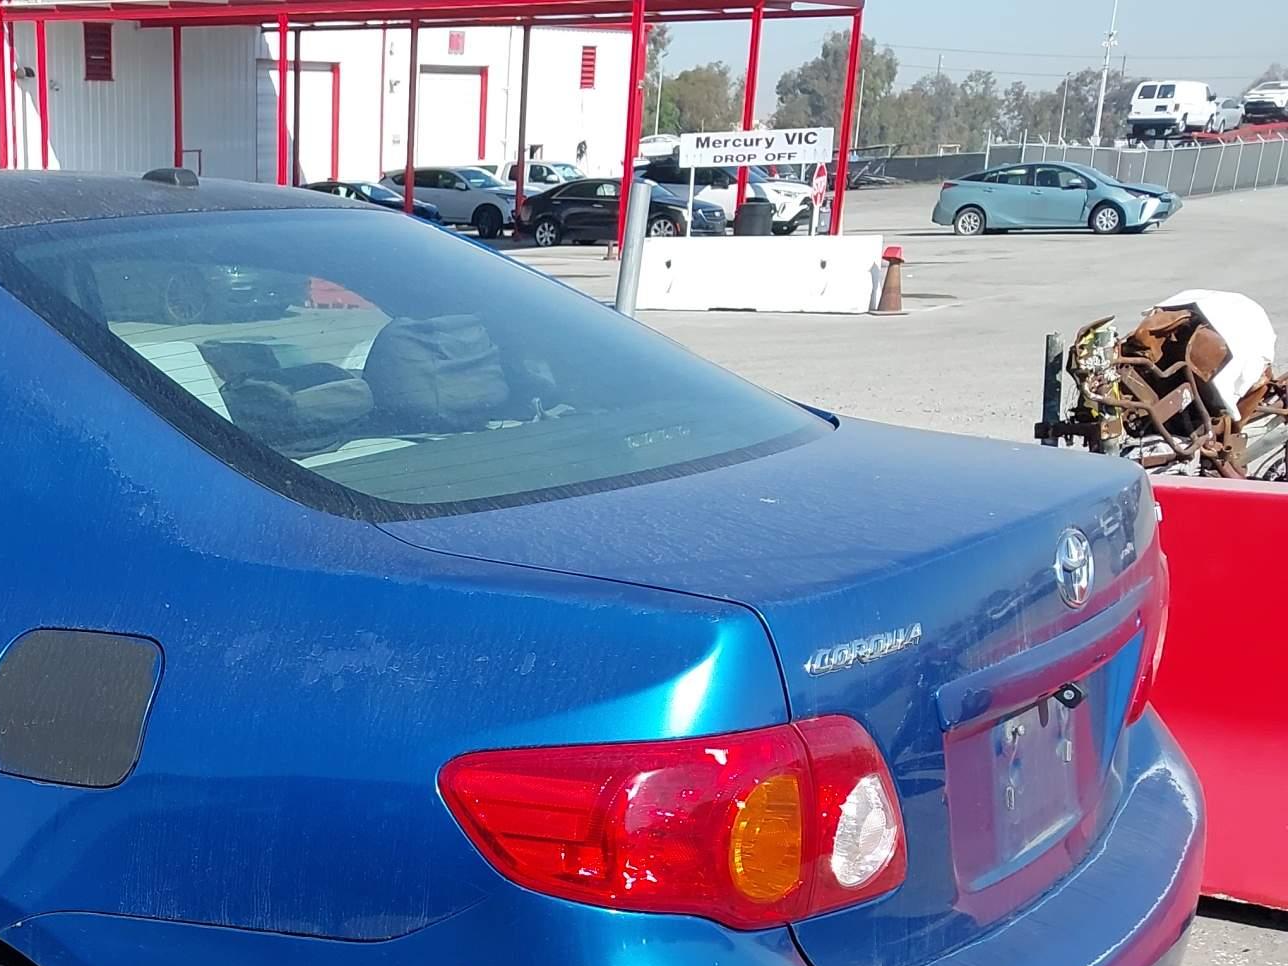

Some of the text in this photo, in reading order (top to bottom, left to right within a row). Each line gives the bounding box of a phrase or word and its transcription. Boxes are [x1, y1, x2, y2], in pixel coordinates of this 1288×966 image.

[695, 131, 818, 149] Mercury VIC
[712, 152, 798, 163] DROP OFF
[803, 622, 922, 677] COROLLA
